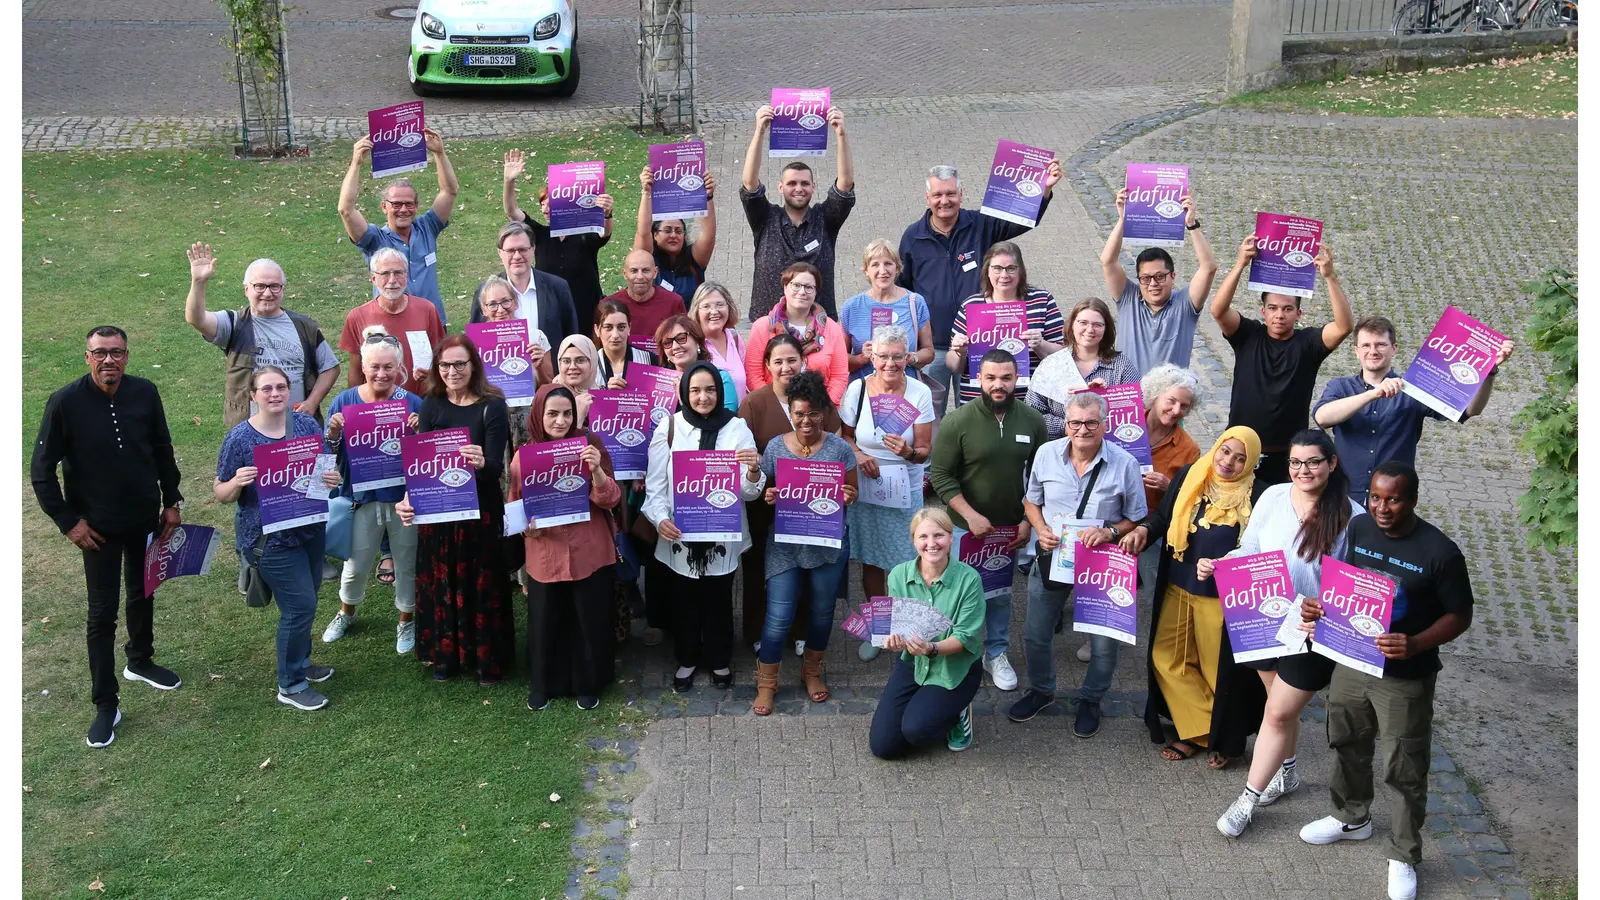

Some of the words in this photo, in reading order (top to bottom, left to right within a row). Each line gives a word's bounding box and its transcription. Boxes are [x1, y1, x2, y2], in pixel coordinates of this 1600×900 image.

[470, 55, 484, 65] SHG
[774, 102, 824, 120] dafür!
[374, 119, 420, 143] dafür!
[654, 161, 701, 183] dafür!
[995, 162, 1046, 183] dafür!
[552, 180, 600, 201] dafür!
[1129, 186, 1183, 206] dafür!
[1257, 235, 1315, 255] dafür!
[1429, 335, 1491, 371] dafür!
[350, 422, 404, 448] dafür!
[592, 413, 645, 436] dafür!
[409, 453, 466, 478] dafür!
[525, 460, 583, 486] dafür!
[677, 473, 735, 497] dafür!
[780, 483, 838, 503] dafür!
[1355, 546, 1383, 560] BILLIE
[1078, 565, 1133, 591] dafür!
[873, 600, 891, 608] dafür!
[1225, 576, 1285, 610] dafür!
[1322, 588, 1386, 621] dafür!
